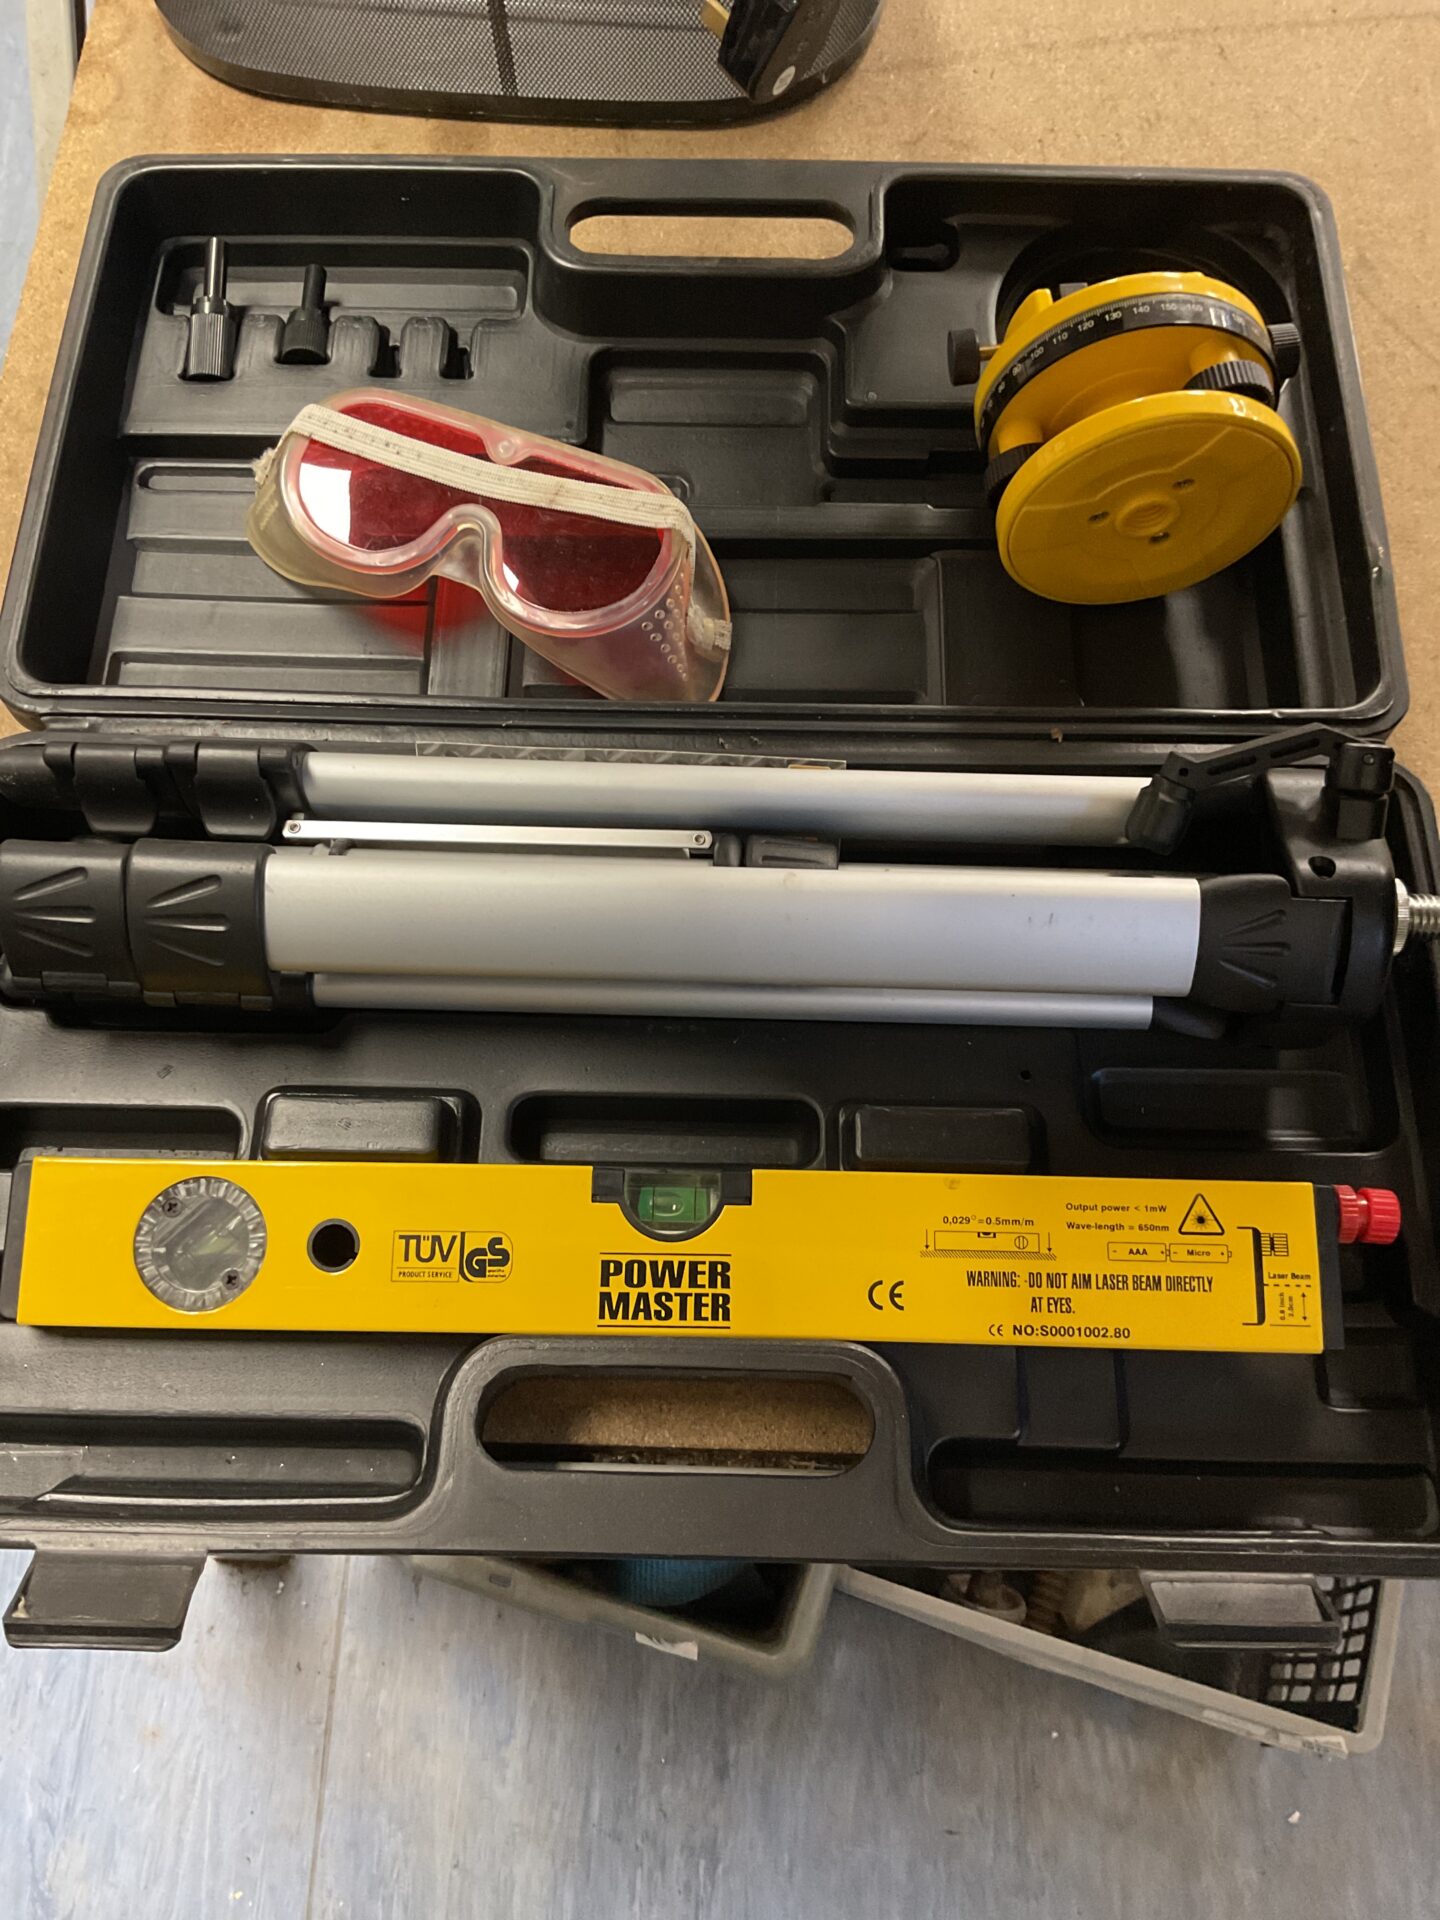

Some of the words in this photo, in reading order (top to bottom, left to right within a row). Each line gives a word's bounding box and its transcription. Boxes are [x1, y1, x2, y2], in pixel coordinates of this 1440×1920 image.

[1030, 346, 1045, 361] 100
[1052, 332, 1069, 345] 110
[1077, 319, 1095, 332] 120
[1104, 311, 1122, 322] 130
[1132, 304, 1150, 315] 140
[1160, 303, 1178, 311] 150
[1065, 1202, 1098, 1213] Output
[1101, 1205, 1130, 1213] power
[1145, 1204, 1167, 1213] 1mW
[1066, 1221, 1125, 1232] Wave-length
[1138, 1223, 1169, 1232] 650nm
[398, 1234, 458, 1263] TÜV
[465, 1237, 511, 1278] GS
[1128, 1248, 1148, 1256] AAA
[1186, 1249, 1211, 1257] Micro
[398, 1271, 426, 1279] PRODUCT
[427, 1271, 452, 1279] SERVICE
[600, 1259, 731, 1289] POWER
[966, 1270, 1021, 1288] WARNING:
[1046, 1272, 1067, 1289] NOT
[1071, 1273, 1092, 1290] AIM
[1095, 1273, 1129, 1291] LASER
[1132, 1274, 1162, 1292] BEAM
[1165, 1275, 1213, 1293] DIRECTLY
[1291, 1272, 1311, 1280] Beam
[598, 1292, 731, 1321] MASTER
[1030, 1296, 1043, 1313] AT
[1047, 1296, 1076, 1314] EYES.
